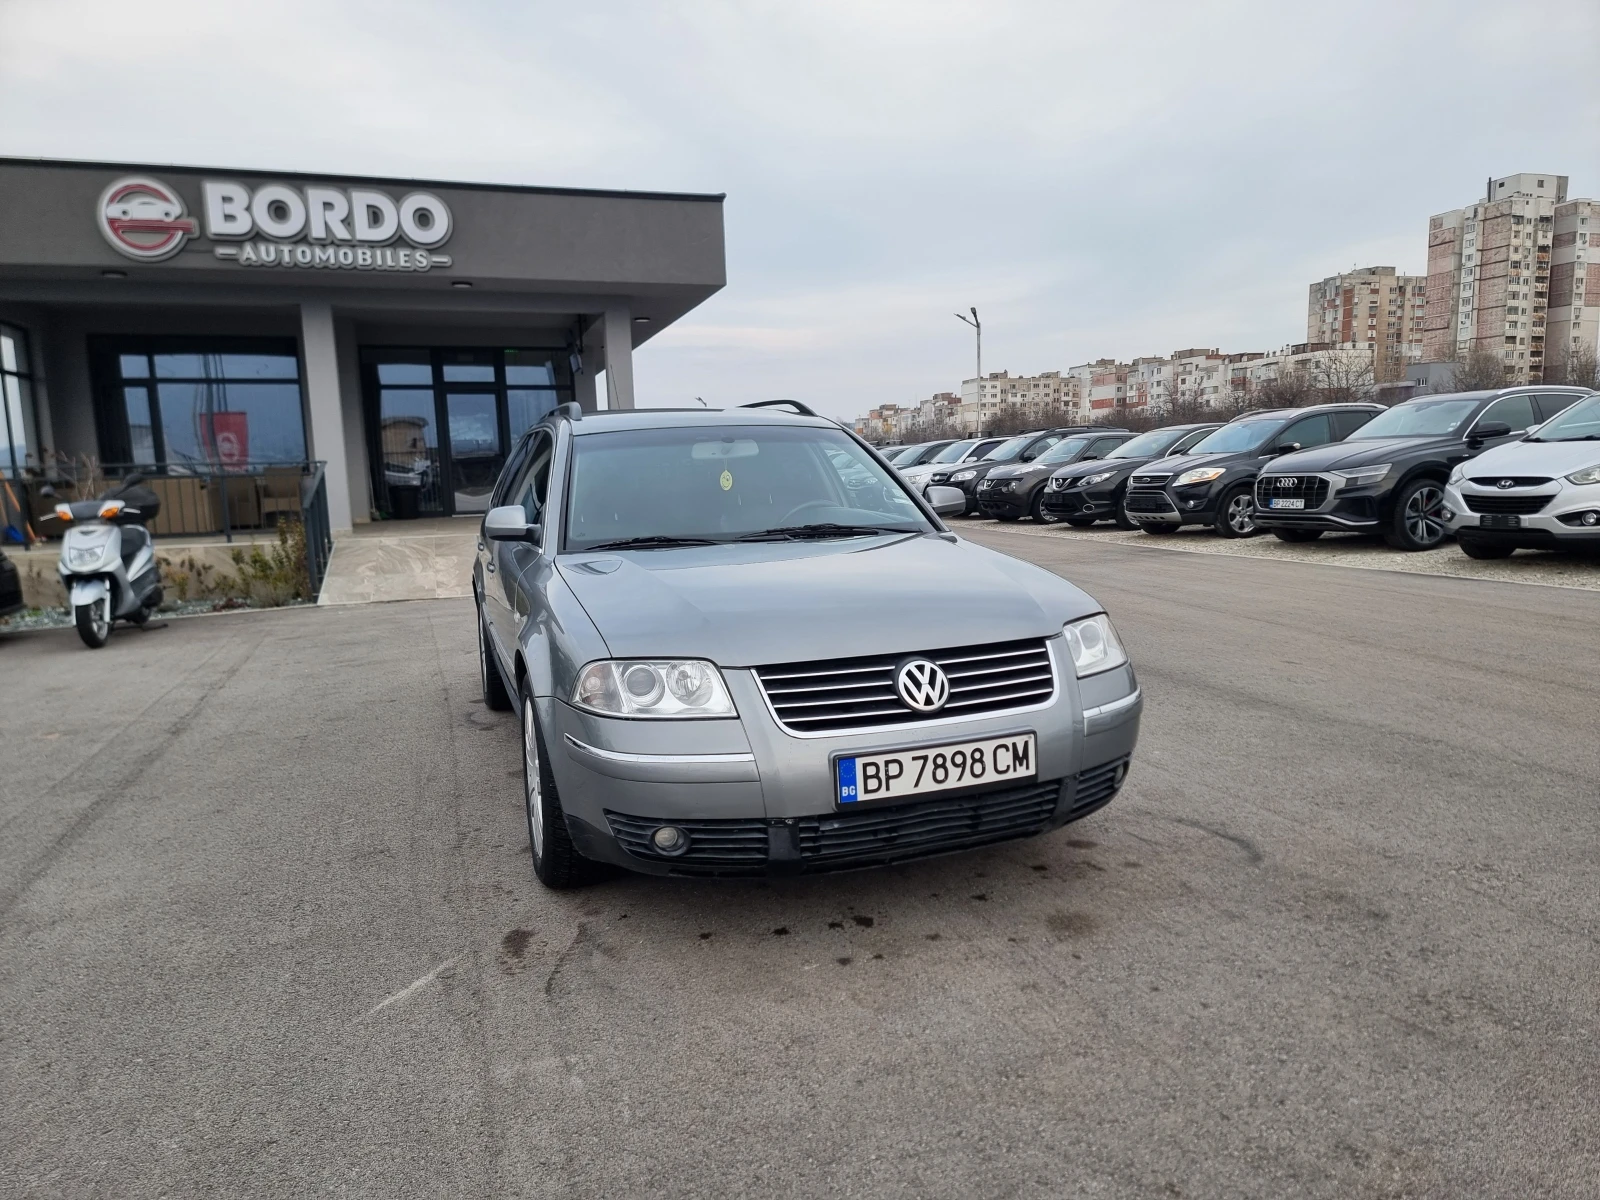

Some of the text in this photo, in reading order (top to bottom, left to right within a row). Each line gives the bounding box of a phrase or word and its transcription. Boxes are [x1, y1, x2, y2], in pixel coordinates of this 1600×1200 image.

[205, 183, 449, 244] BORDO
[242, 243, 428, 267] AUTOMOBILES
[899, 660, 949, 711] VW
[841, 786, 856, 797] BG
[862, 740, 1030, 794] BP 7898 CM
